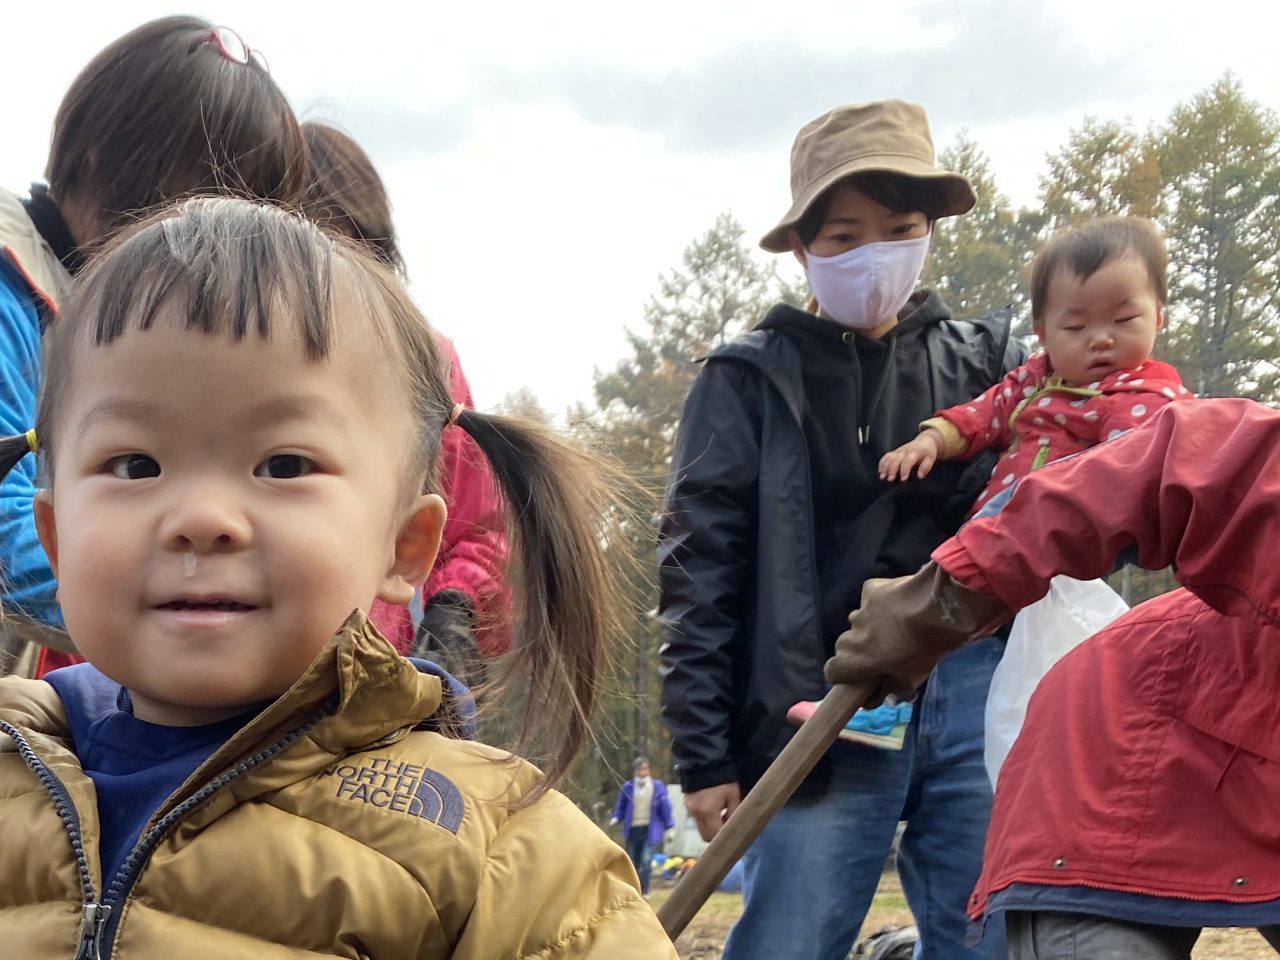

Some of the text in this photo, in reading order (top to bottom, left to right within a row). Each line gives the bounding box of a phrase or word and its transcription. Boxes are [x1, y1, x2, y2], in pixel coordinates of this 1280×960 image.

[318, 764, 418, 796] NORTH
[369, 757, 424, 776] THE
[336, 778, 412, 813] FACE
